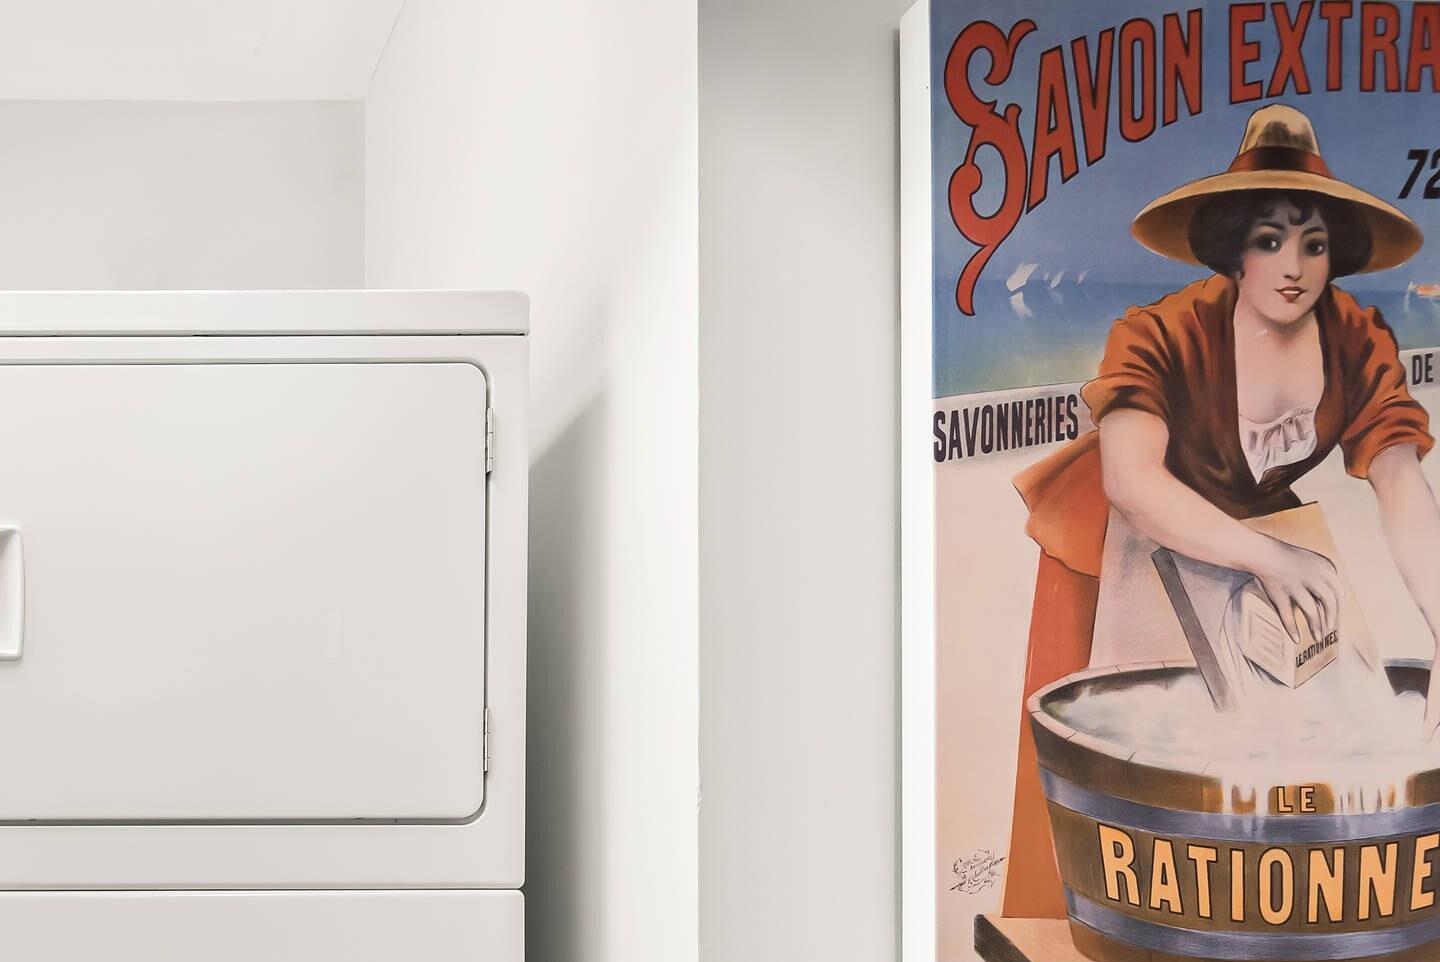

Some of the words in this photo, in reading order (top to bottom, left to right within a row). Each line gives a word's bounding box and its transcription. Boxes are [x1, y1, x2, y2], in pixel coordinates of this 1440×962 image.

[944, 8, 1202, 316] SAVON
[1412, 354, 1434, 386] DE
[933, 394, 1078, 462] SAVONNERIES
[1277, 786, 1316, 813] LE
[1097, 822, 1440, 925] RATIONNE
